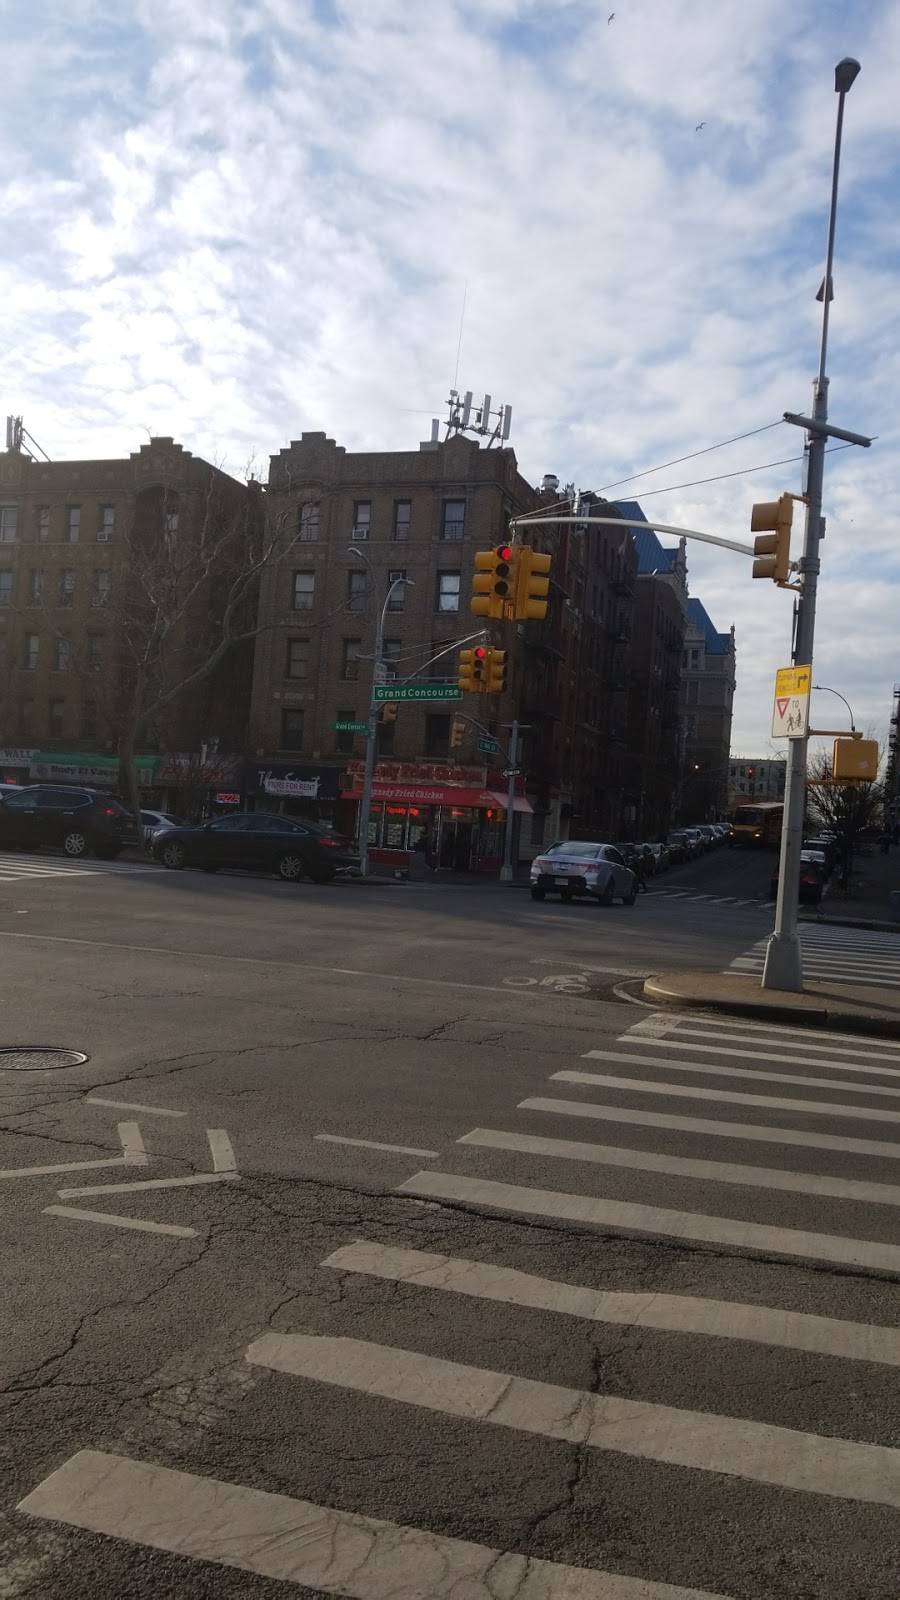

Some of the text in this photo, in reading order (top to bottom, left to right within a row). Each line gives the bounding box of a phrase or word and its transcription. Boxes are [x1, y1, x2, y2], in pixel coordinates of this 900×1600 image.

[377, 688, 459, 698] Grand Concourse
[4, 749, 33, 759] WALL
[394, 789, 415, 798] Fried
[415, 790, 444, 800] Chicken
